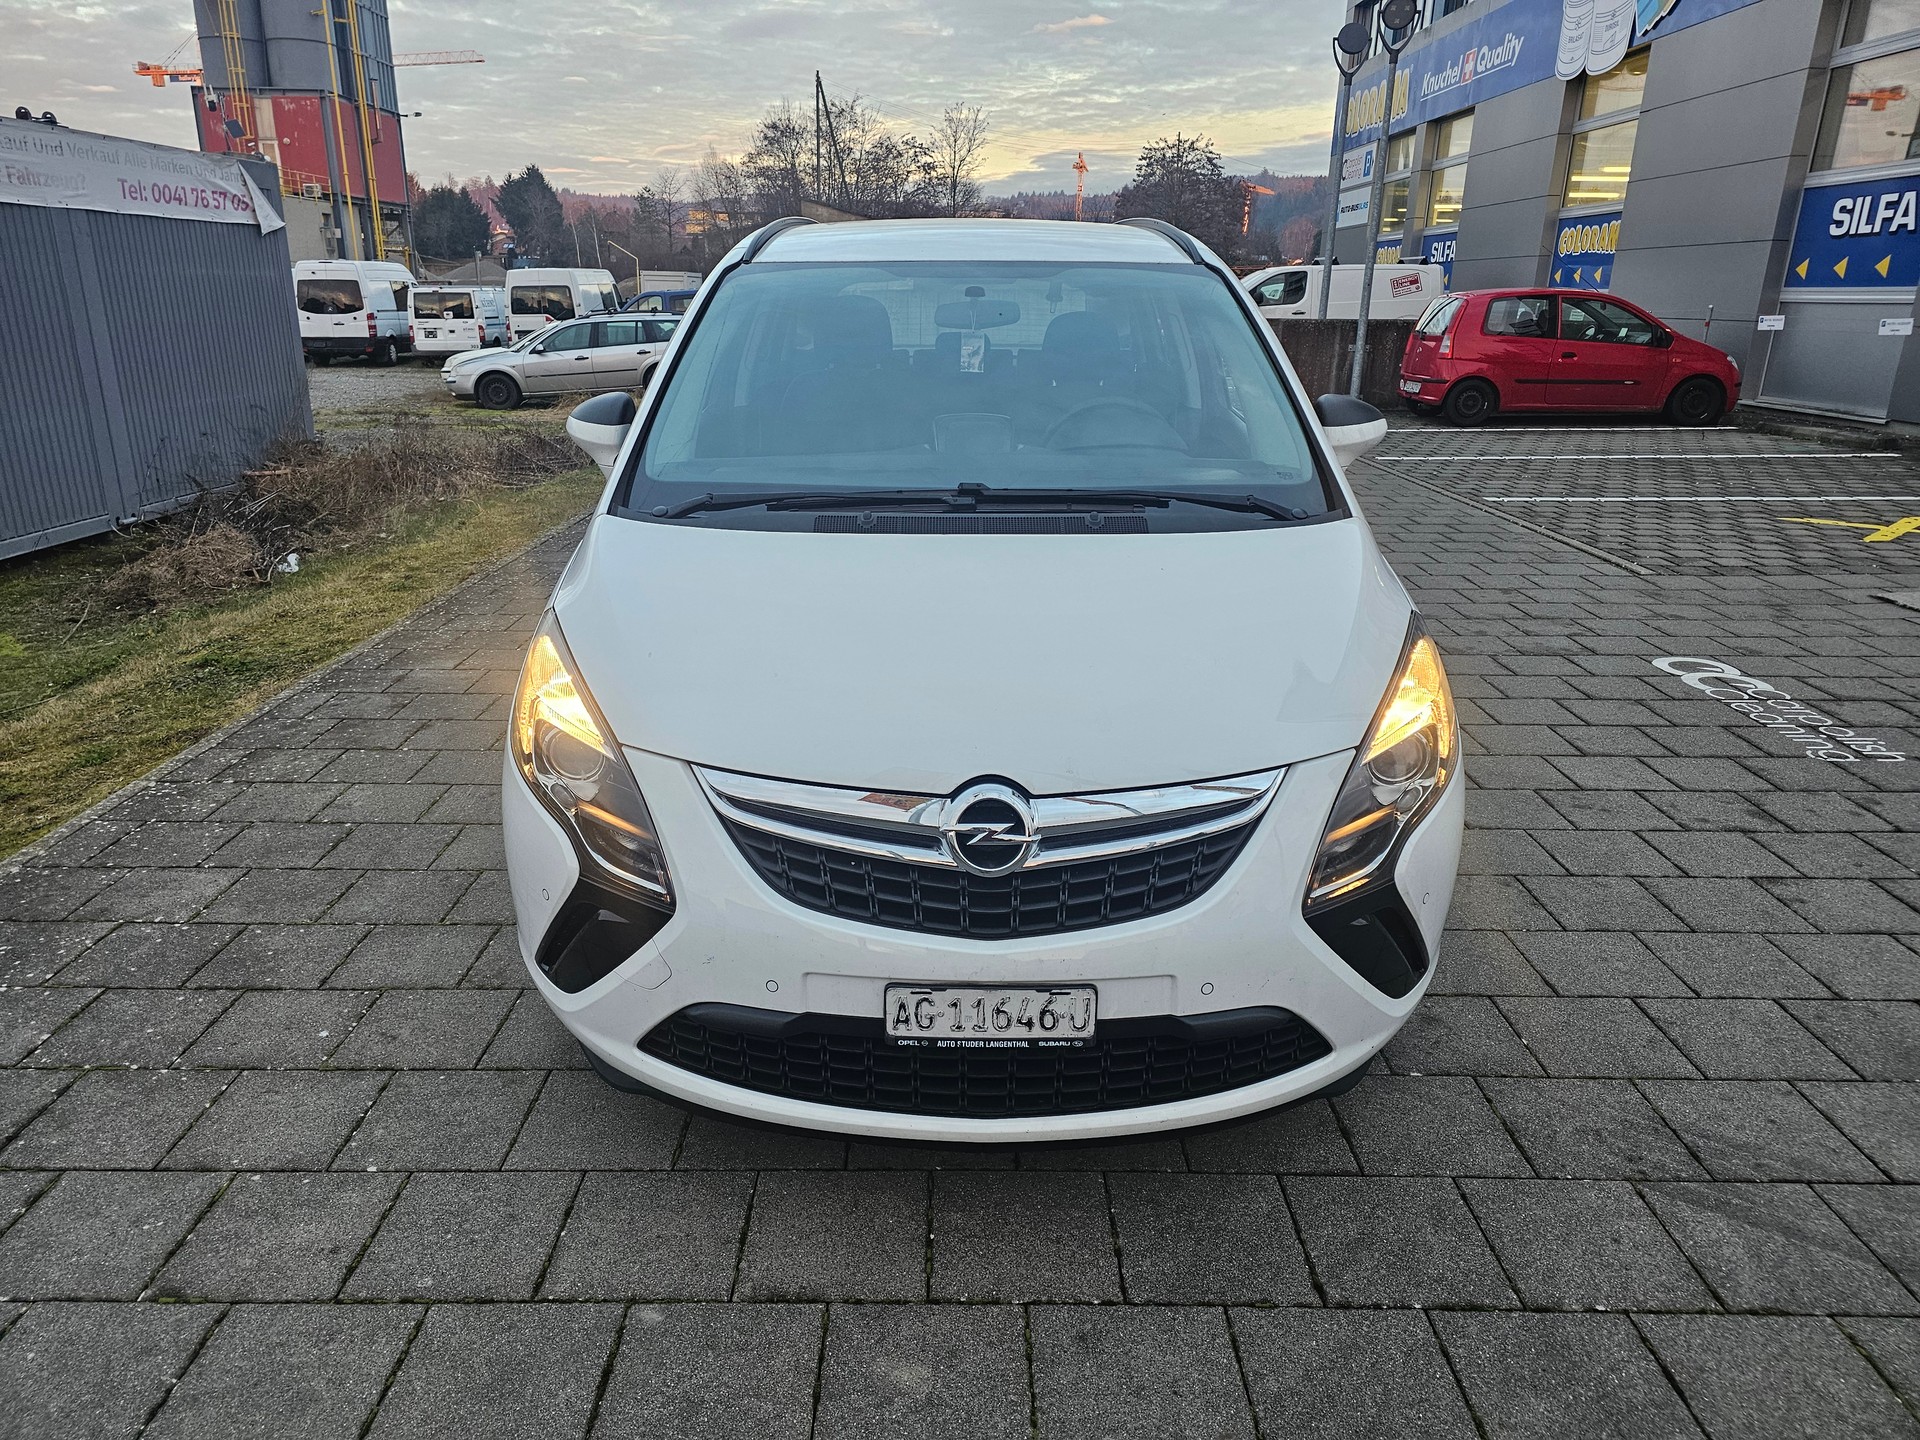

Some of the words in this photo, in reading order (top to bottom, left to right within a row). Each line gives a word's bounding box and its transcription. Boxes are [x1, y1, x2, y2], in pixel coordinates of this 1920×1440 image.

[1421, 55, 1464, 97] Knuchel
[1476, 32, 1525, 73] Quality
[33, 137, 64, 157] Und
[66, 141, 122, 165] Verkauf
[124, 151, 148, 168] Alle
[151, 156, 194, 176] Marken
[117, 178, 149, 202] Tel:
[152, 183, 188, 207] 0041
[191, 188, 209, 209] 76
[211, 190, 228, 210] 57
[1829, 190, 1918, 237] SILFA
[1430, 240, 1457, 263] SILFA
[937, 1040, 956, 1048] AUTO
[985, 1040, 1030, 1048] LANGENTHAL
